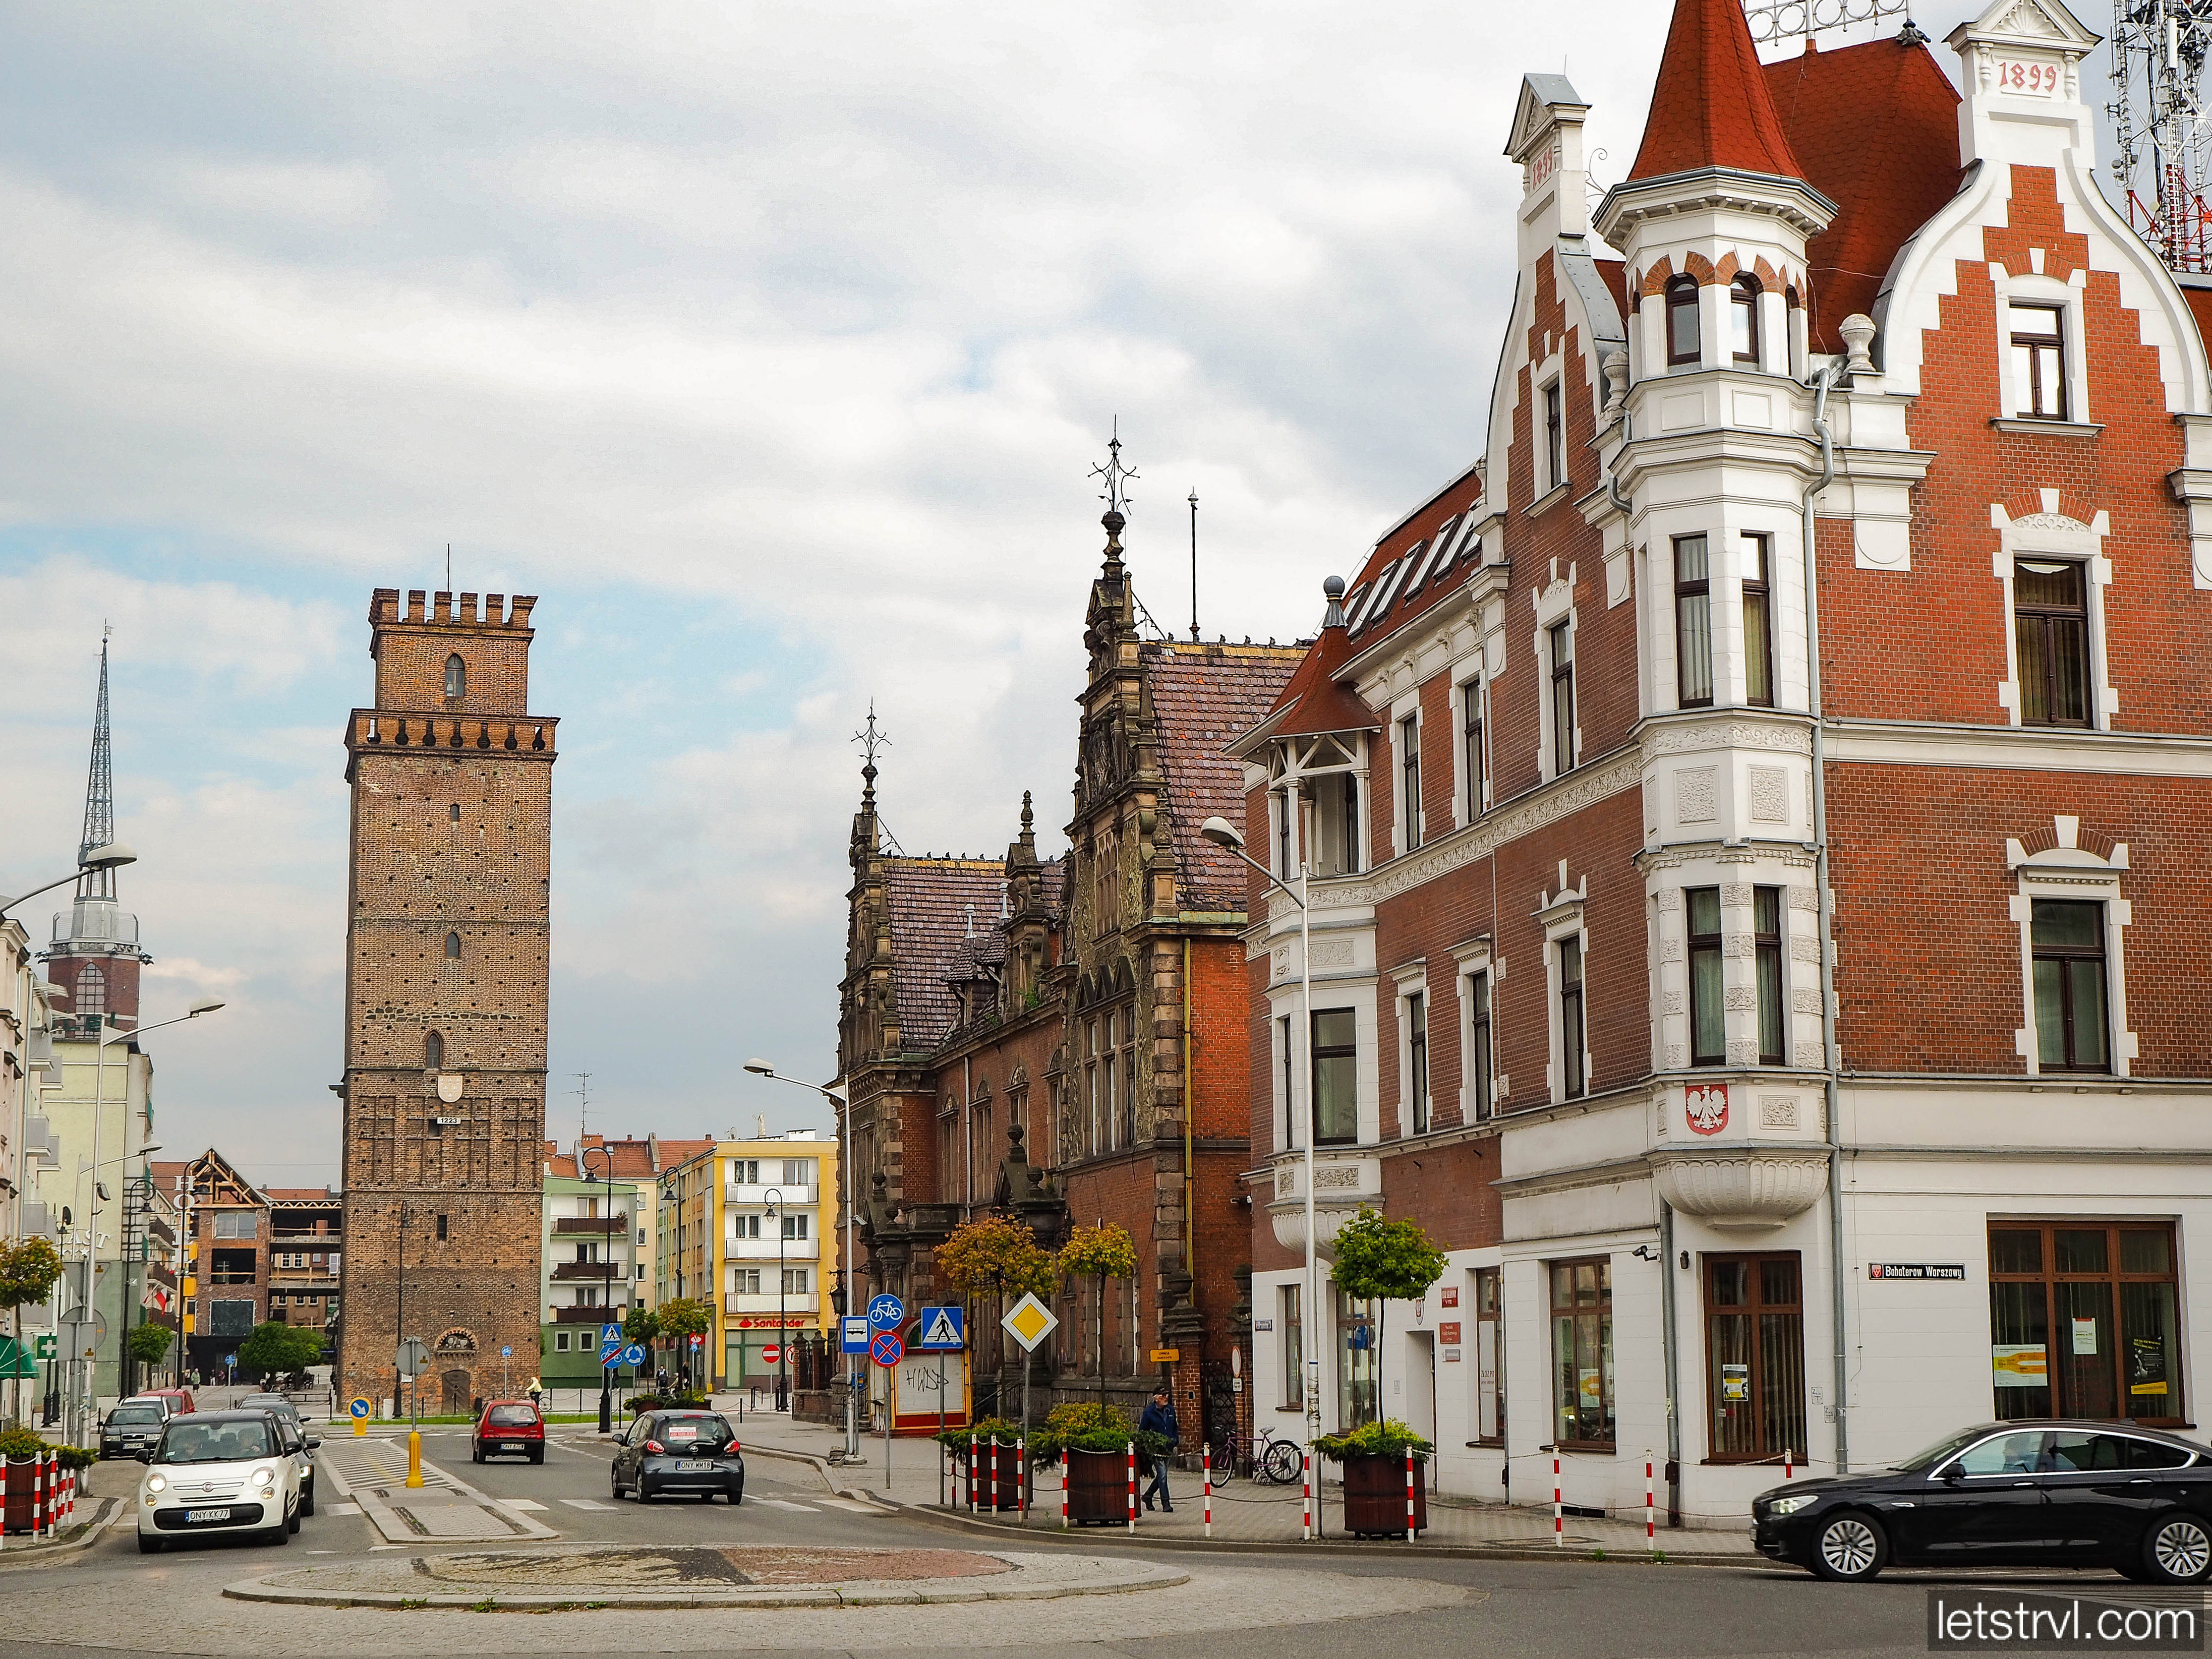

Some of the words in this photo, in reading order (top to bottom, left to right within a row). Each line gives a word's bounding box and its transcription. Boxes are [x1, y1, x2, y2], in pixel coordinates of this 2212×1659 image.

[1998, 62, 2057, 92] 1899
[1533, 146, 1552, 190] 1899
[173, 1175, 196, 1263] HOTEL
[1925, 1266, 1962, 1279] Warszawy
[753, 1318, 805, 1328] Santander
[190, 1511, 207, 1519] ONY
[209, 1510, 228, 1518] KK77
